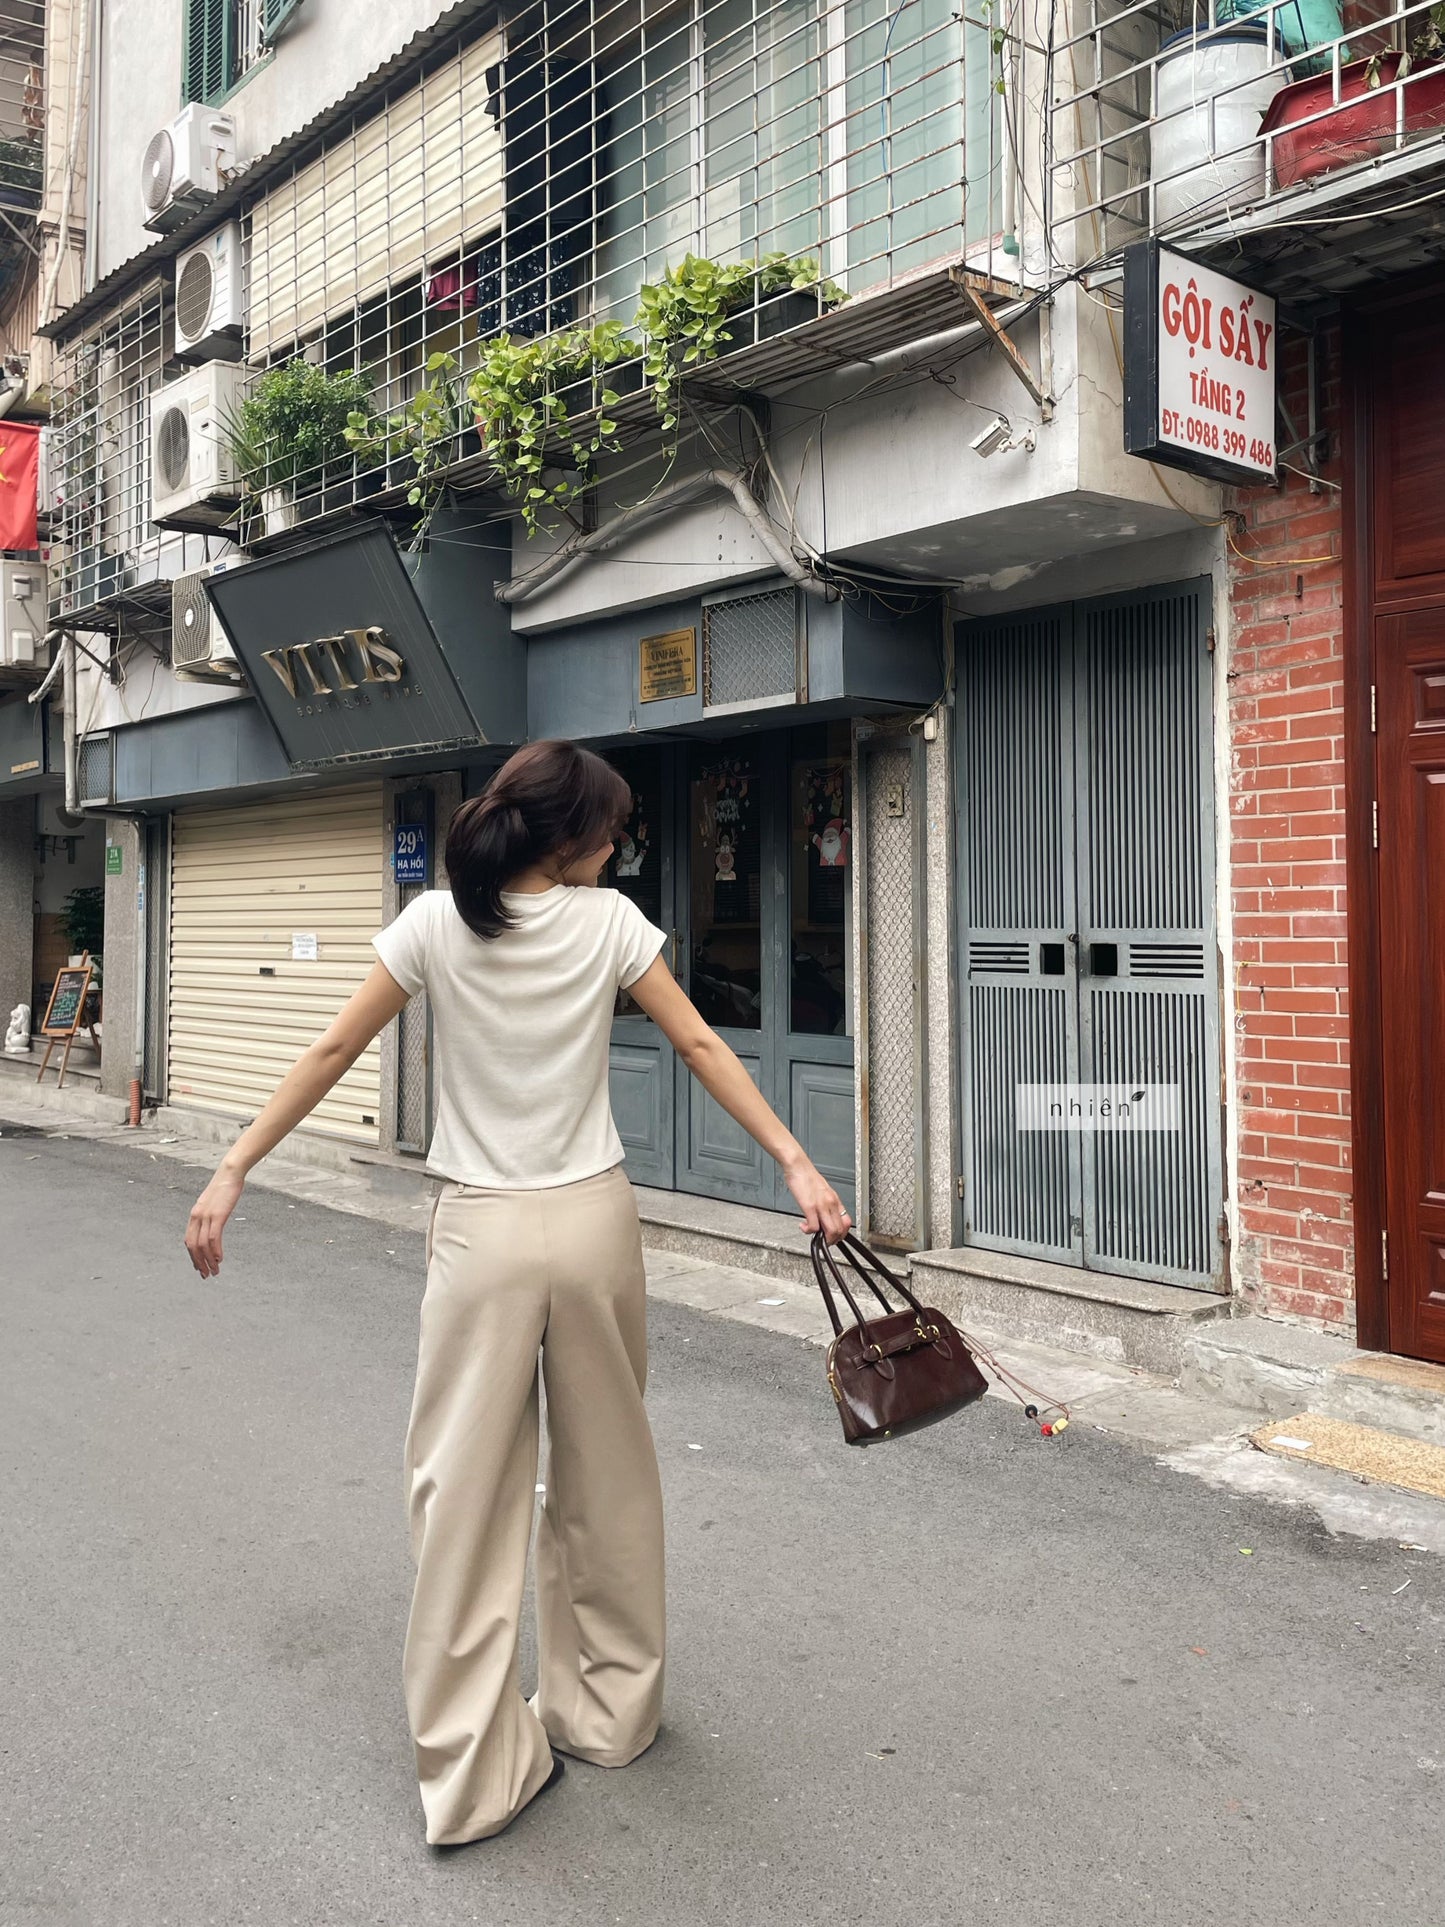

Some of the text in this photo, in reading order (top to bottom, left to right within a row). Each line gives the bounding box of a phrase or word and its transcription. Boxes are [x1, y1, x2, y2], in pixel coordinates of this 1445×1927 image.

[1162, 277, 1272, 371] GỘI SẤY
[1189, 367, 1246, 421] TẦNG 2
[1162, 408, 1272, 468] ĐT: 0988 399 486
[260, 625, 403, 699] VITIS
